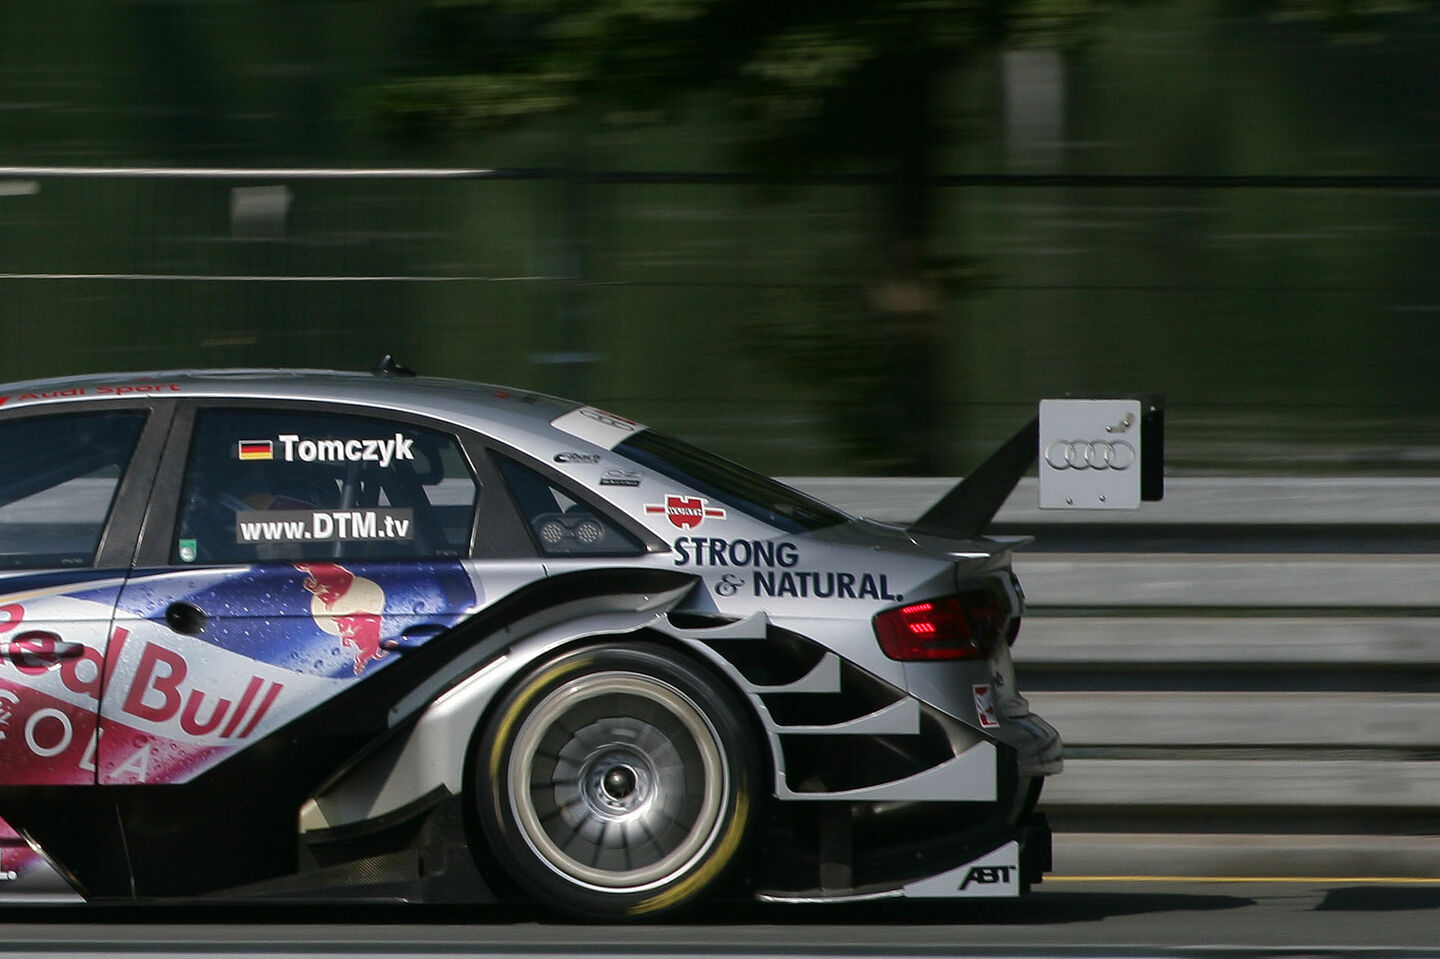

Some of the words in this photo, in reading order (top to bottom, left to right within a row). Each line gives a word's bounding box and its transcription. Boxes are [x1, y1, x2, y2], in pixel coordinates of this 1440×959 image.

[18, 388, 86, 401] Audi
[96, 381, 181, 395] Sport
[278, 433, 414, 467] Tomczyk
[240, 512, 409, 540] www.DTM.tv
[674, 537, 799, 568] STRONG
[715, 573, 745, 597] &
[753, 571, 905, 602] NATURAL.
[122, 640, 284, 739] Bull
[958, 865, 1017, 890] ABT
